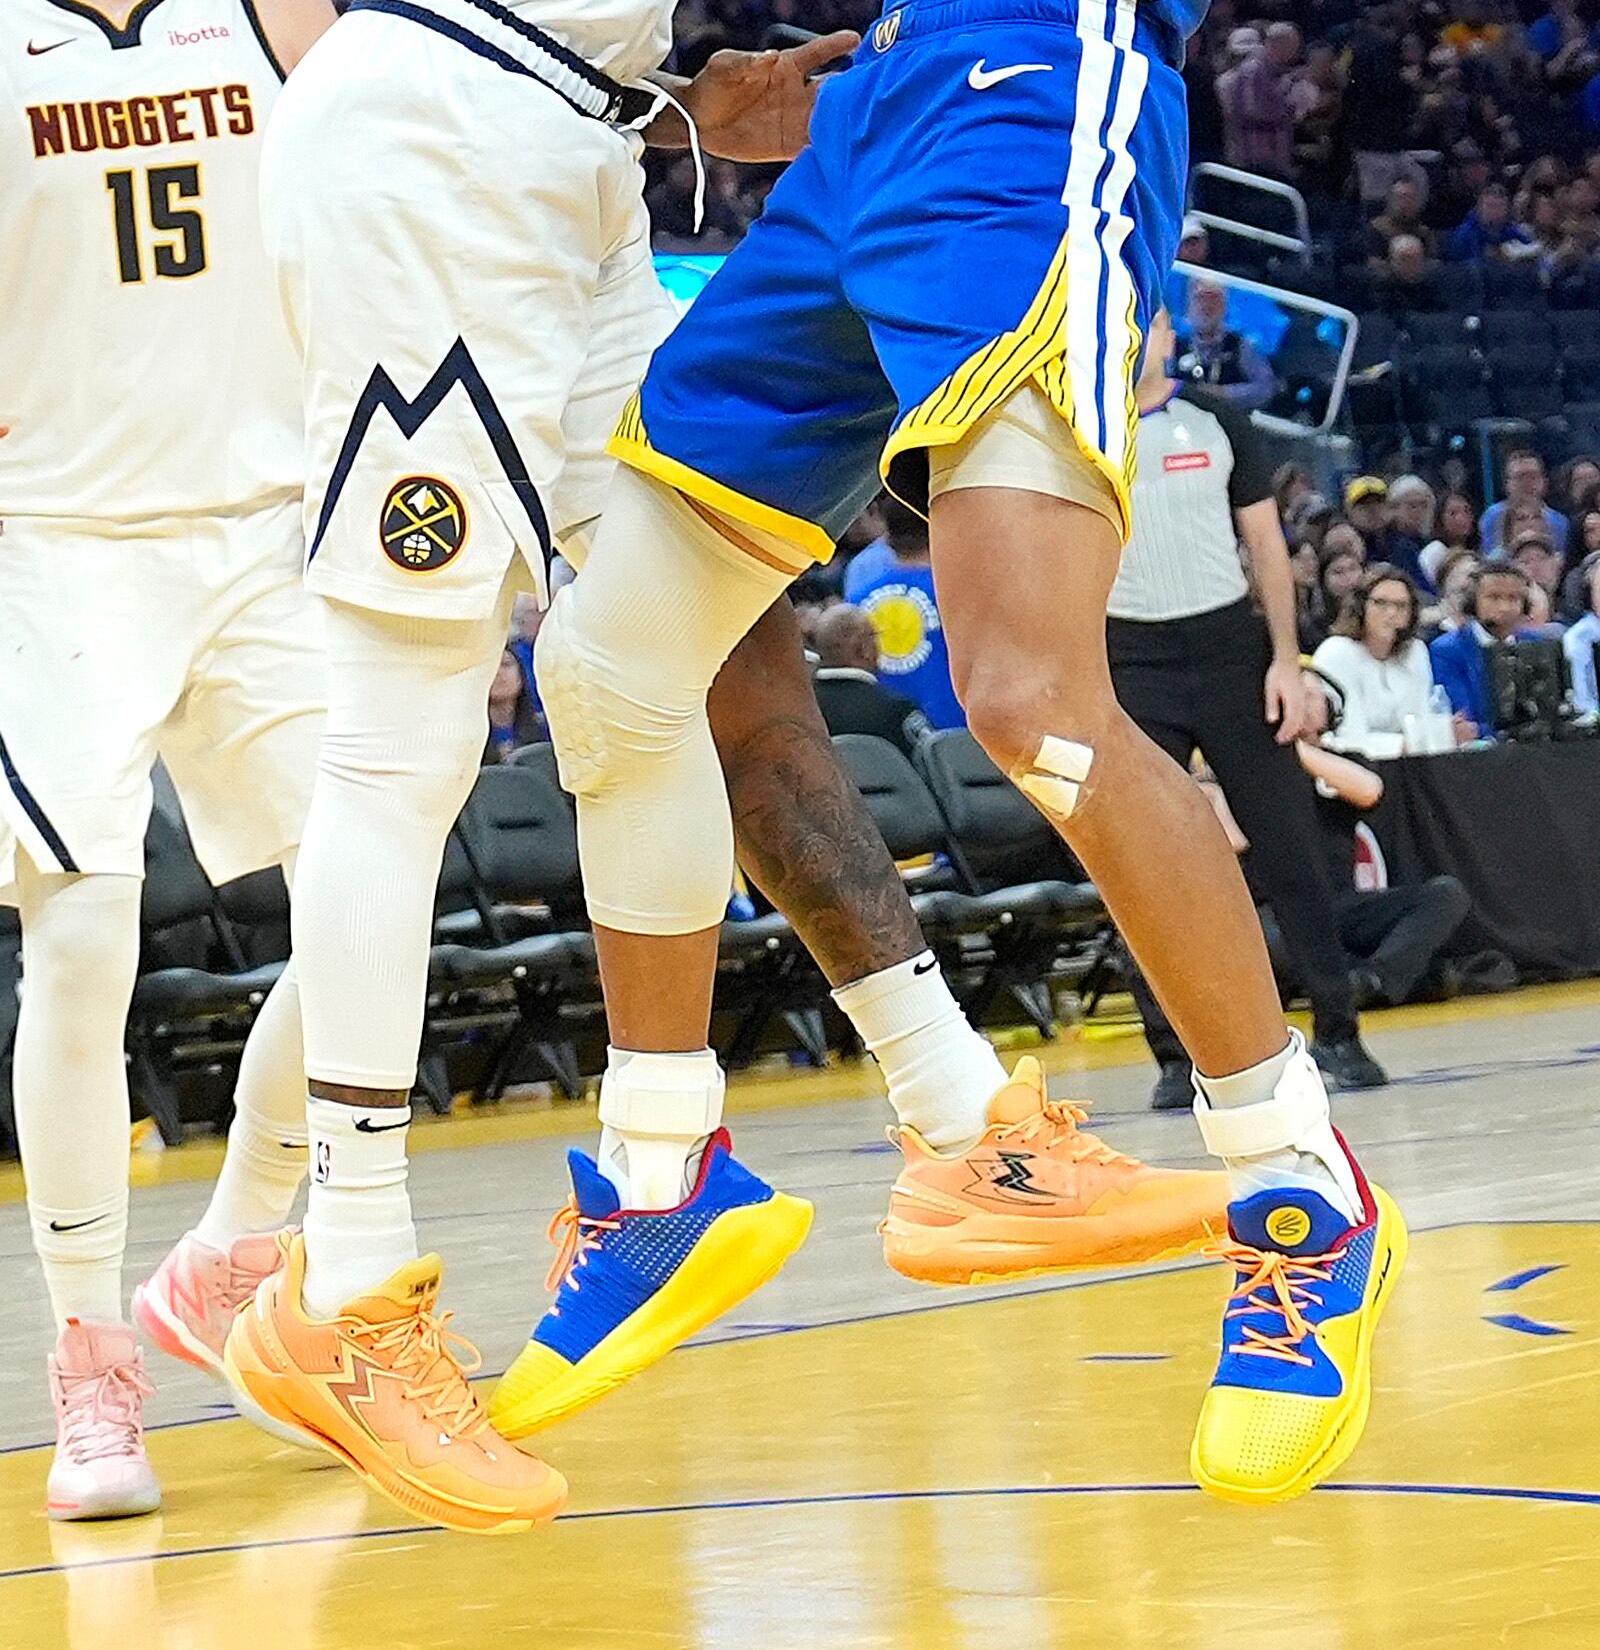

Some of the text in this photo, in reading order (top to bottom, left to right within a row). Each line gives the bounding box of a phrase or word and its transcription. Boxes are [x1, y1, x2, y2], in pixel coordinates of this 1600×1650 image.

[168, 24, 231, 47] ibotta
[24, 83, 256, 159] NUGGETS
[104, 161, 209, 285] 15
